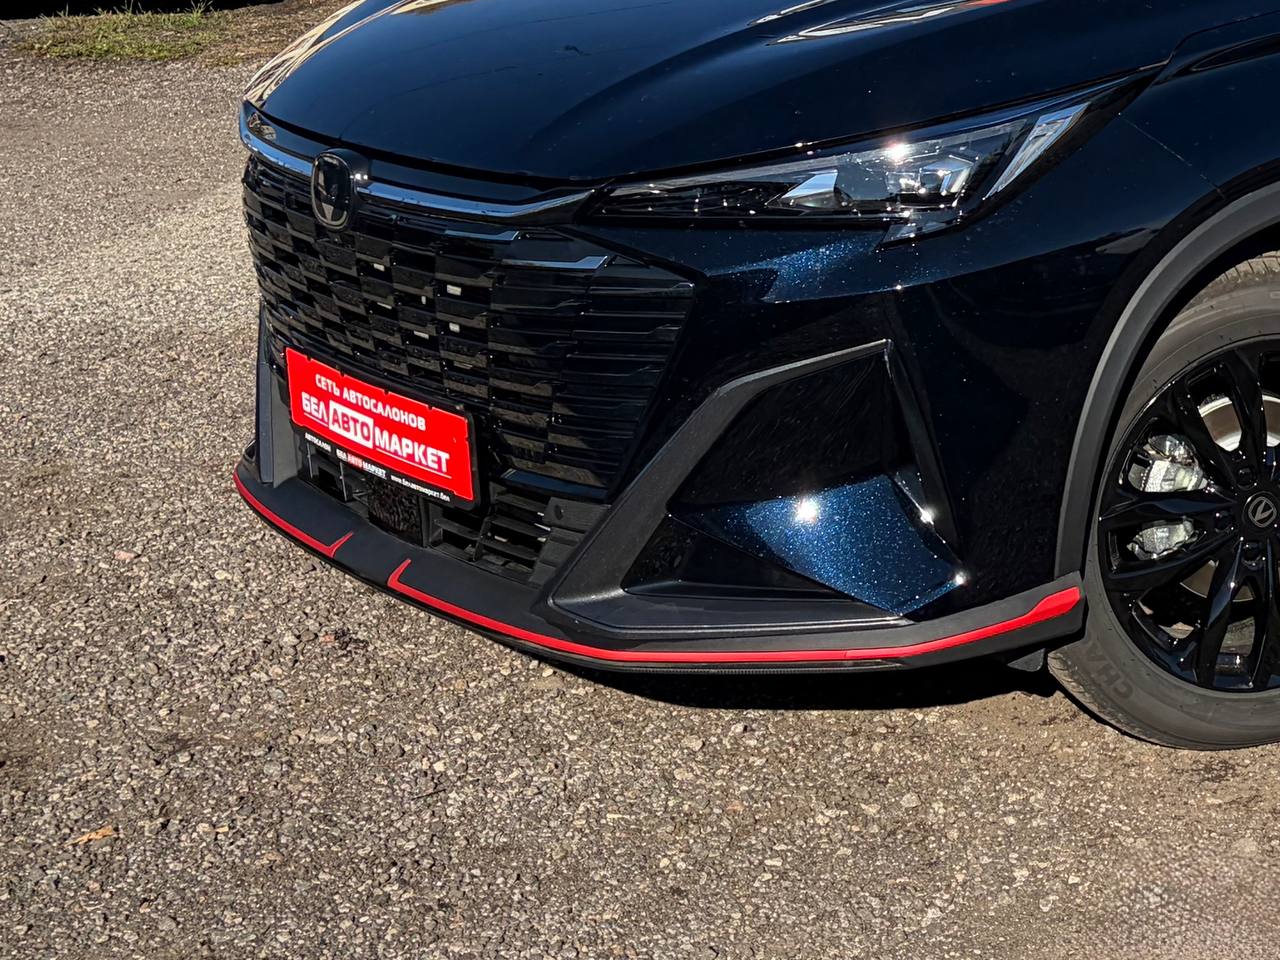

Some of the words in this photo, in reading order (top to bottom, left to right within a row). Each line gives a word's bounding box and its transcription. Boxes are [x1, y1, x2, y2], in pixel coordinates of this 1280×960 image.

[301, 391, 328, 423] БЕЛ
[330, 405, 371, 442] АВТО
[374, 426, 450, 473] МАРКЕТ
[315, 373, 340, 396] СЕТЬ
[342, 387, 426, 431] АВТОСАЛОНОВ
